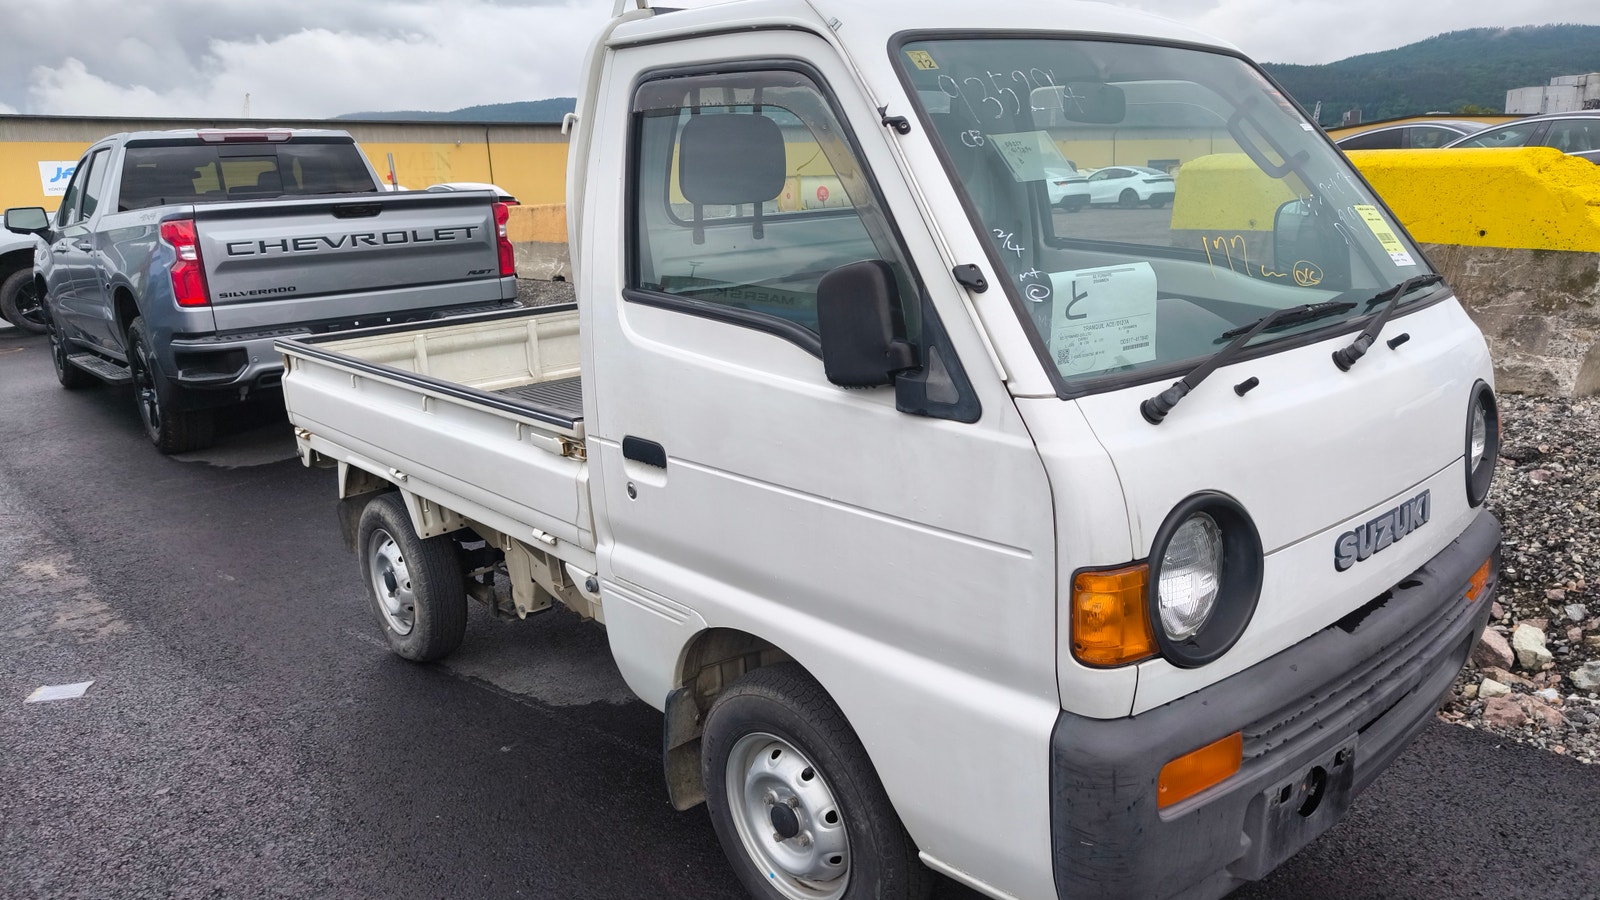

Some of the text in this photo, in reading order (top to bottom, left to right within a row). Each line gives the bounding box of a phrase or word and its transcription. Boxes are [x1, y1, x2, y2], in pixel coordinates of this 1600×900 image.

[917, 58, 935, 69] 12
[226, 225, 479, 257] CHEVROLET
[467, 268, 496, 276] RST
[219, 286, 297, 299] SILVERADO
[1065, 280, 1088, 320] と
[1334, 488, 1430, 573] SUZUKI
